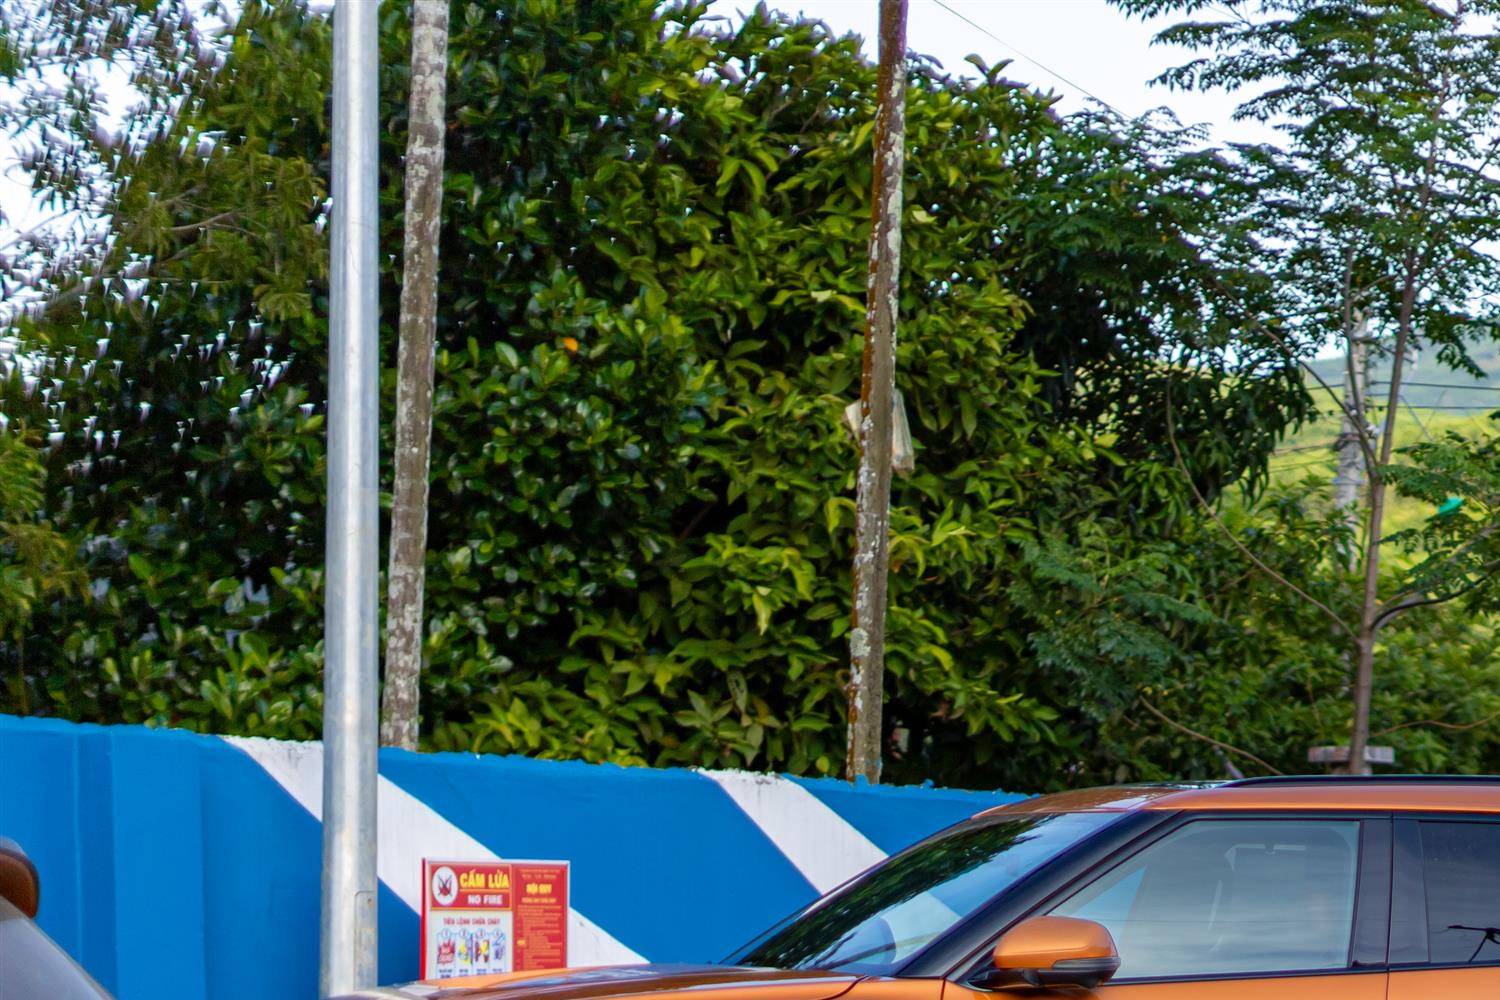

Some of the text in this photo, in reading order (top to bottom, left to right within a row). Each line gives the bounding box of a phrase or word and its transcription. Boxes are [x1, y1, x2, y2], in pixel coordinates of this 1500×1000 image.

[460, 868, 509, 888] CẤM LỬA
[468, 894, 503, 904] NO FIRE
